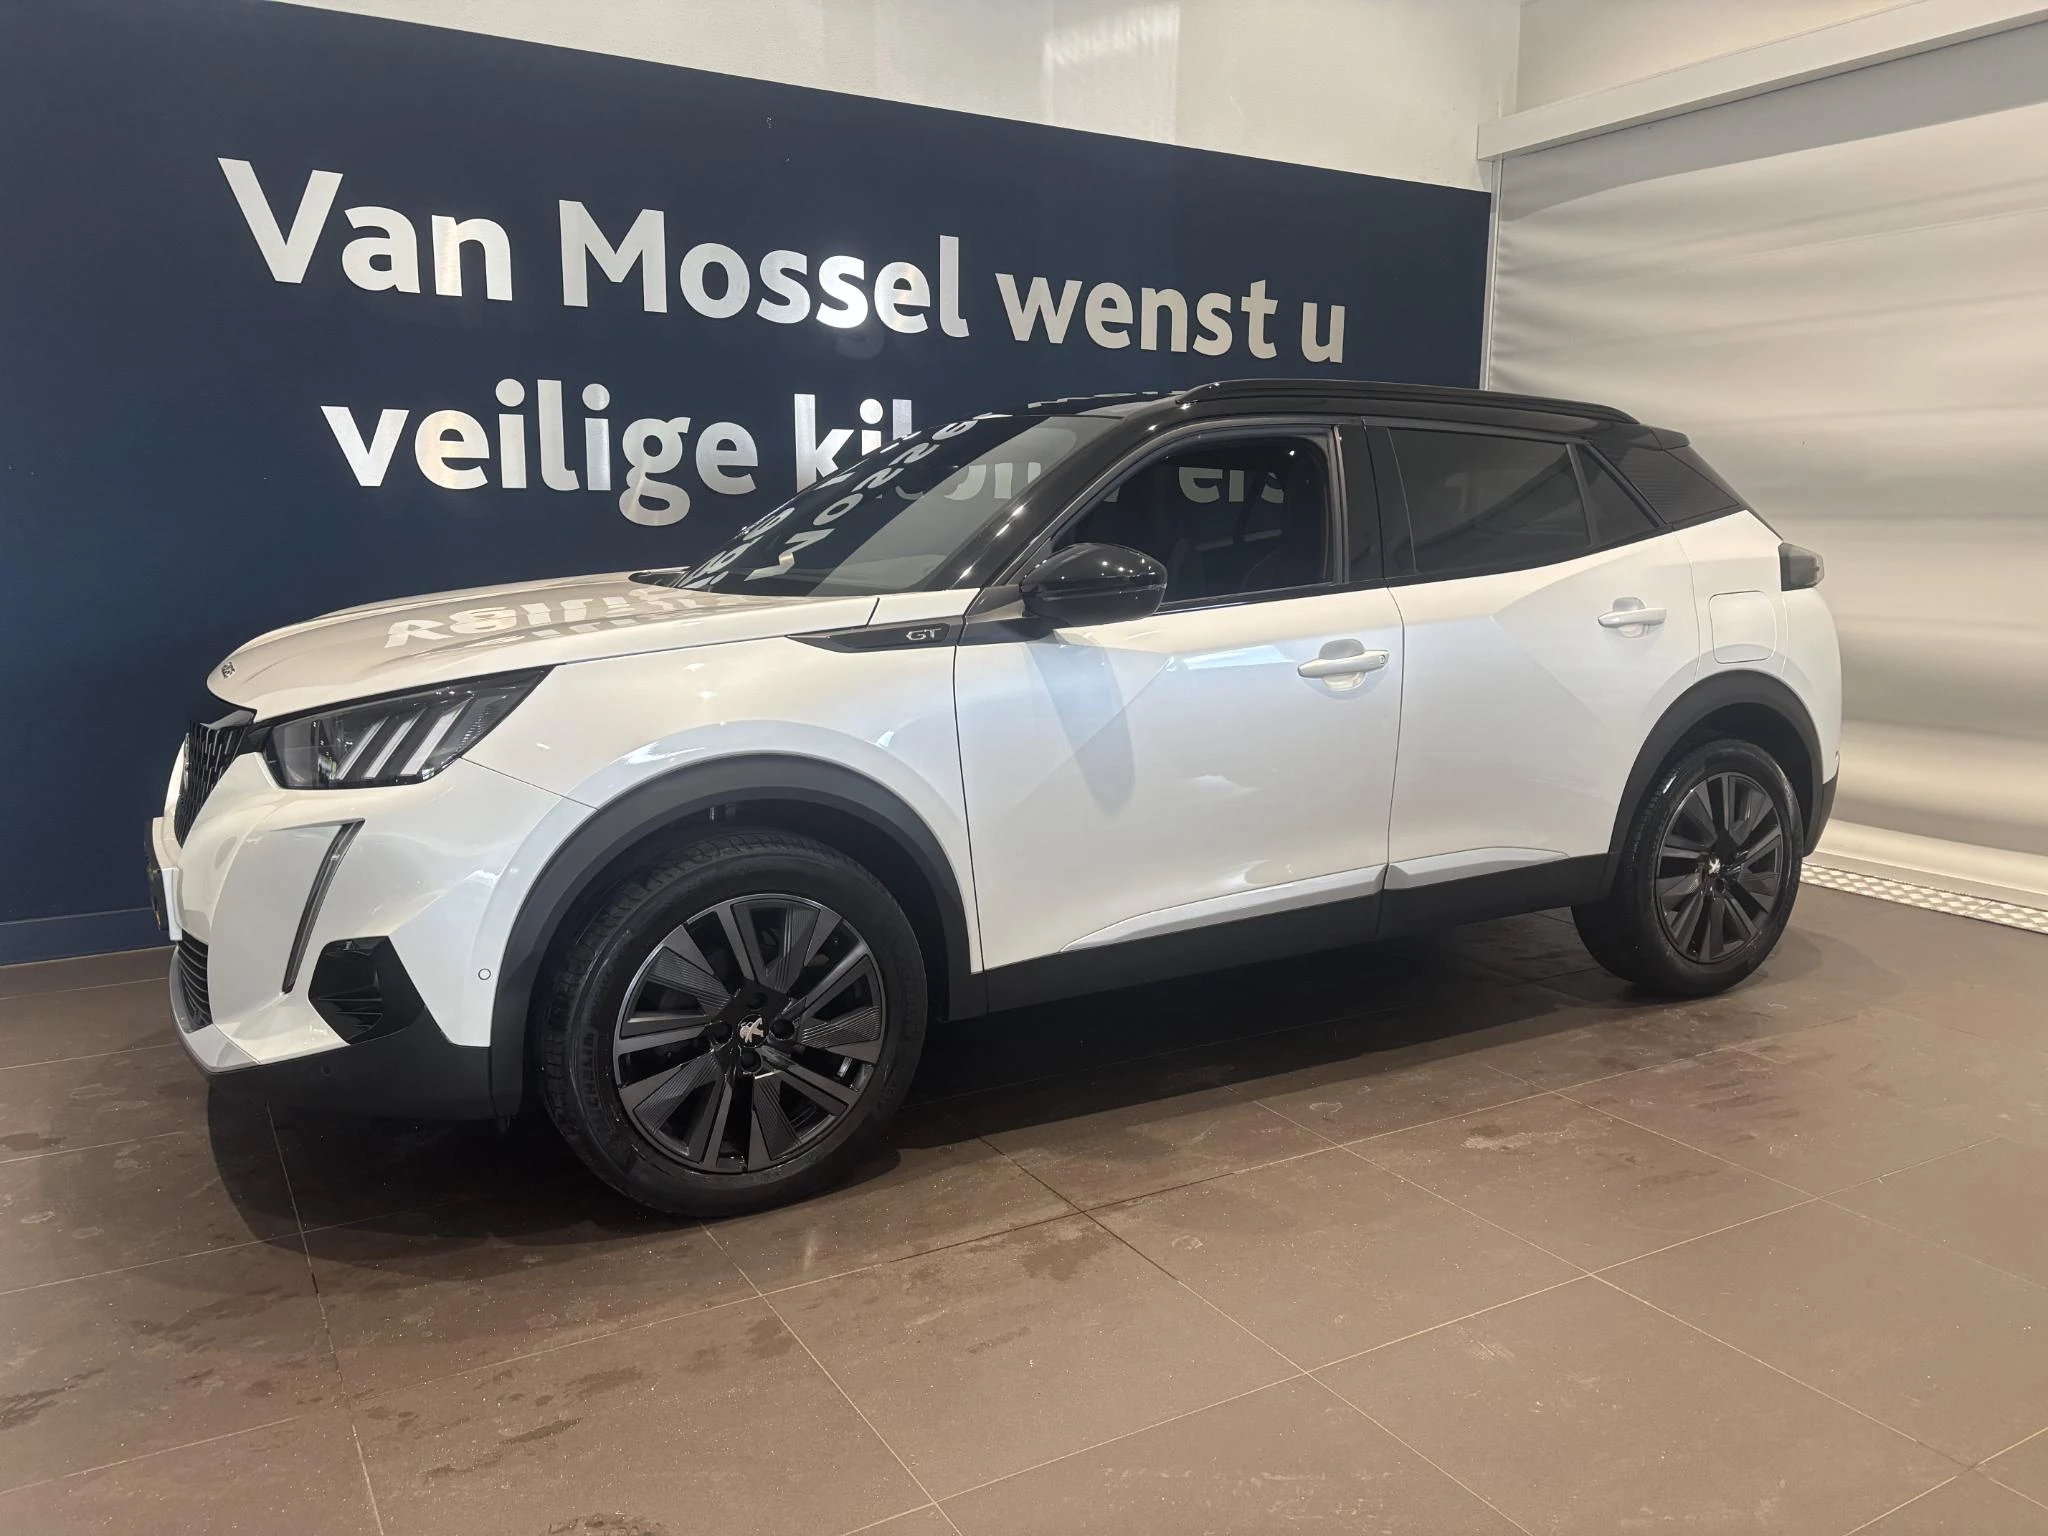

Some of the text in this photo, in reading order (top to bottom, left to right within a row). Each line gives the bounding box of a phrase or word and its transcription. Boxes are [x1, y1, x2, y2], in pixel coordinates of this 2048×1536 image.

[218, 157, 1346, 363] Van Mossel wenst u
[320, 378, 759, 527] veilige
[906, 628, 942, 641] GT
